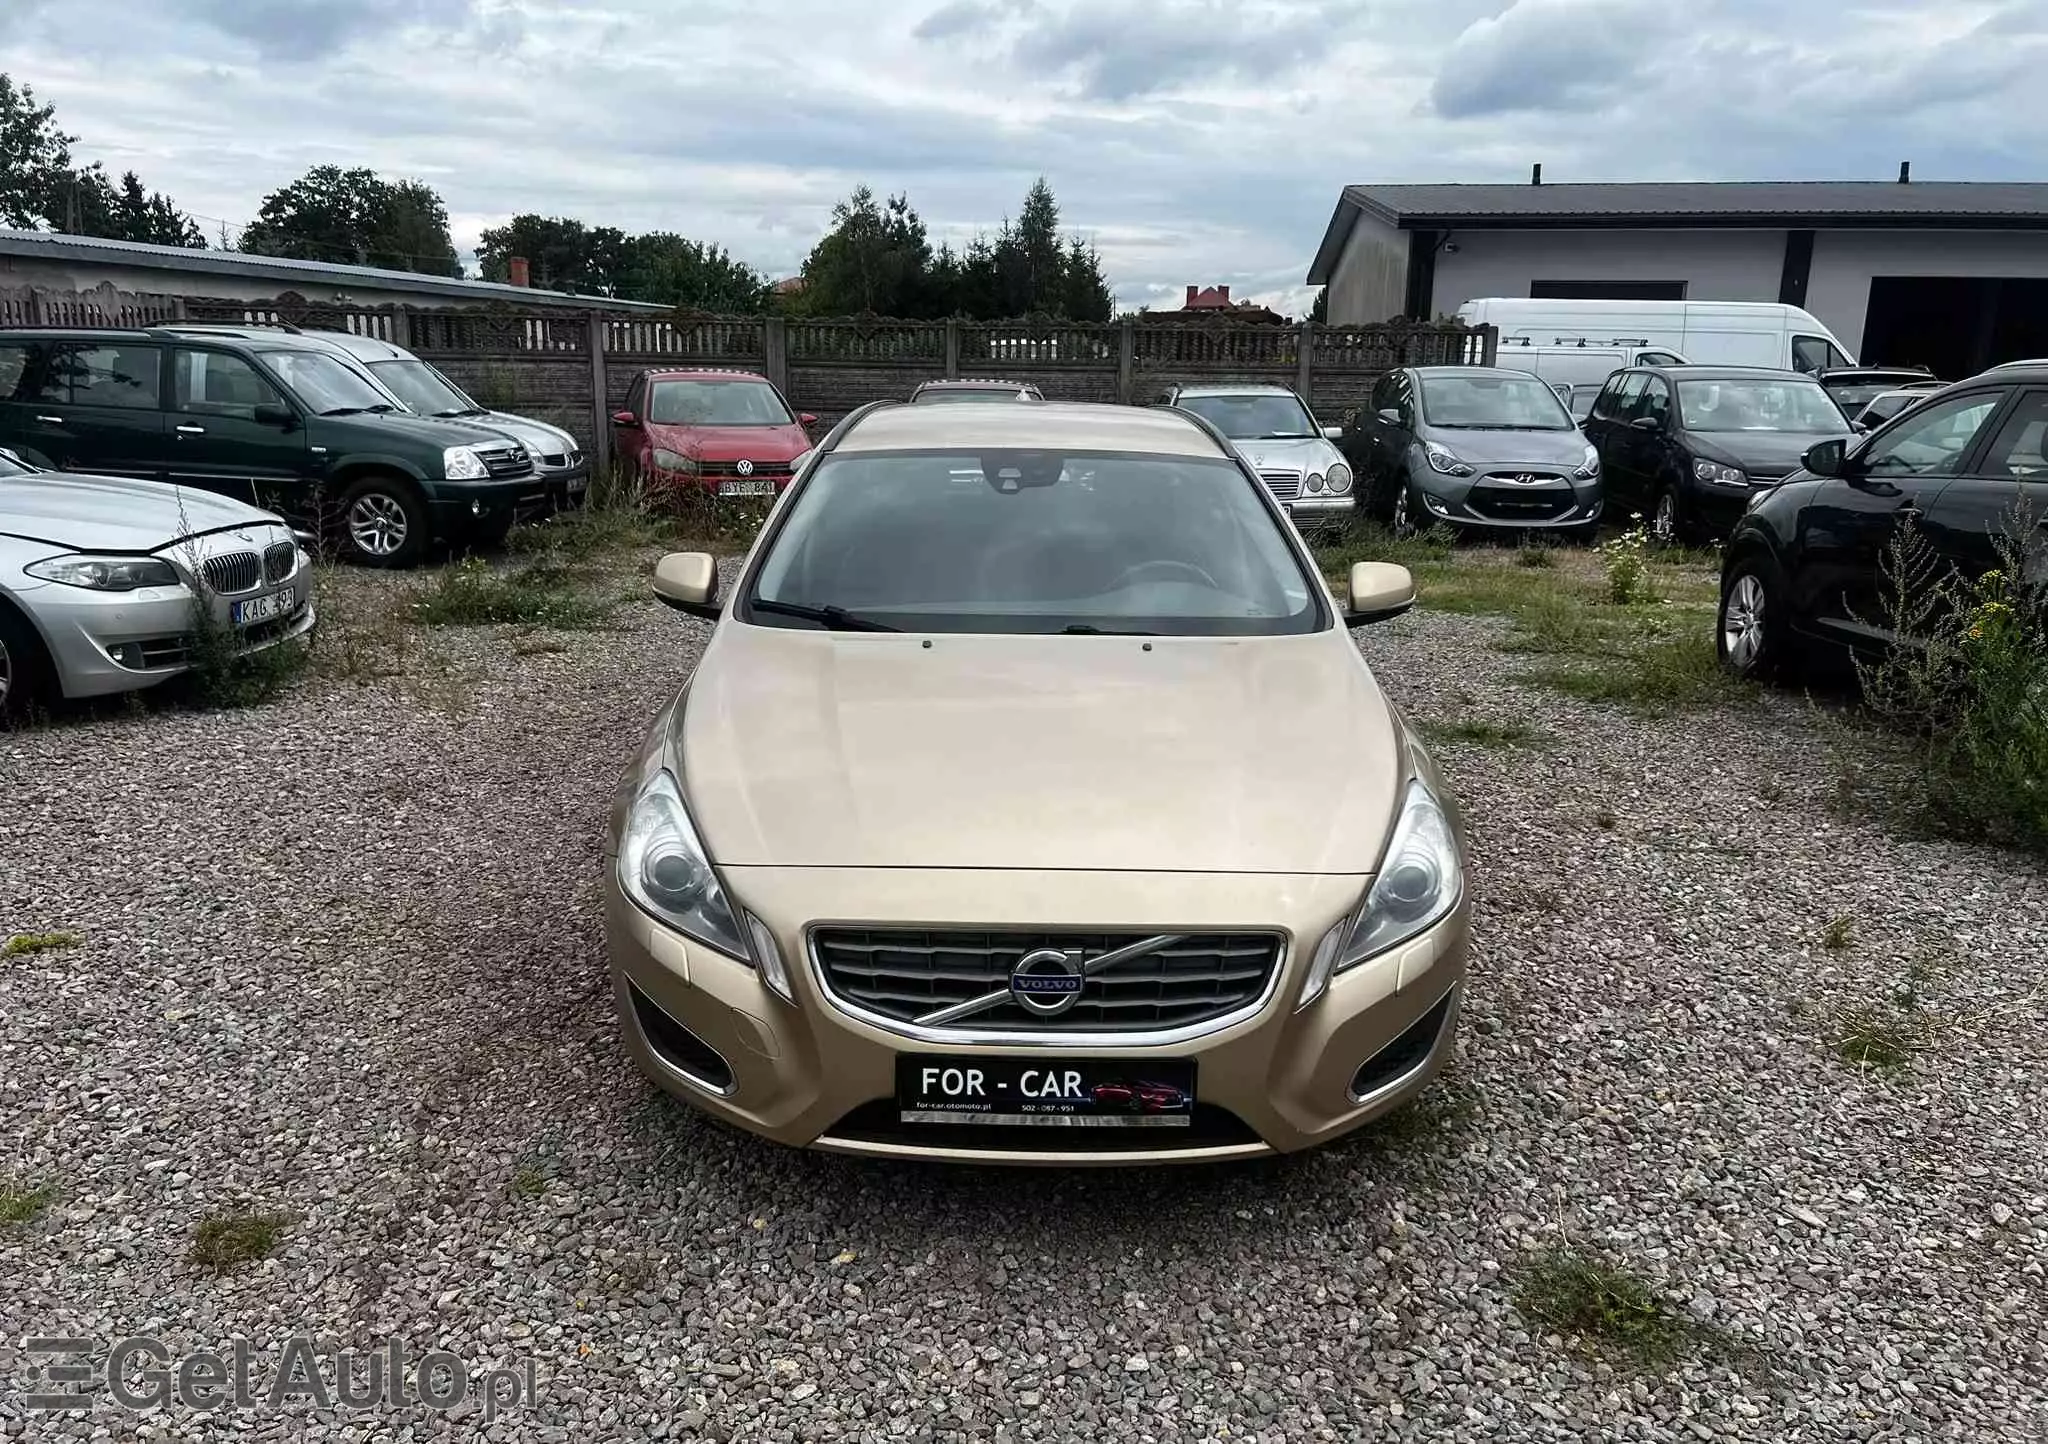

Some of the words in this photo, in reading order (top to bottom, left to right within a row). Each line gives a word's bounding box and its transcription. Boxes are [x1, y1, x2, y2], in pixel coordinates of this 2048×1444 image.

[1017, 979, 1077, 989] VOLVO
[921, 1067, 987, 1096] FOR
[1019, 1070, 1083, 1098] CAR
